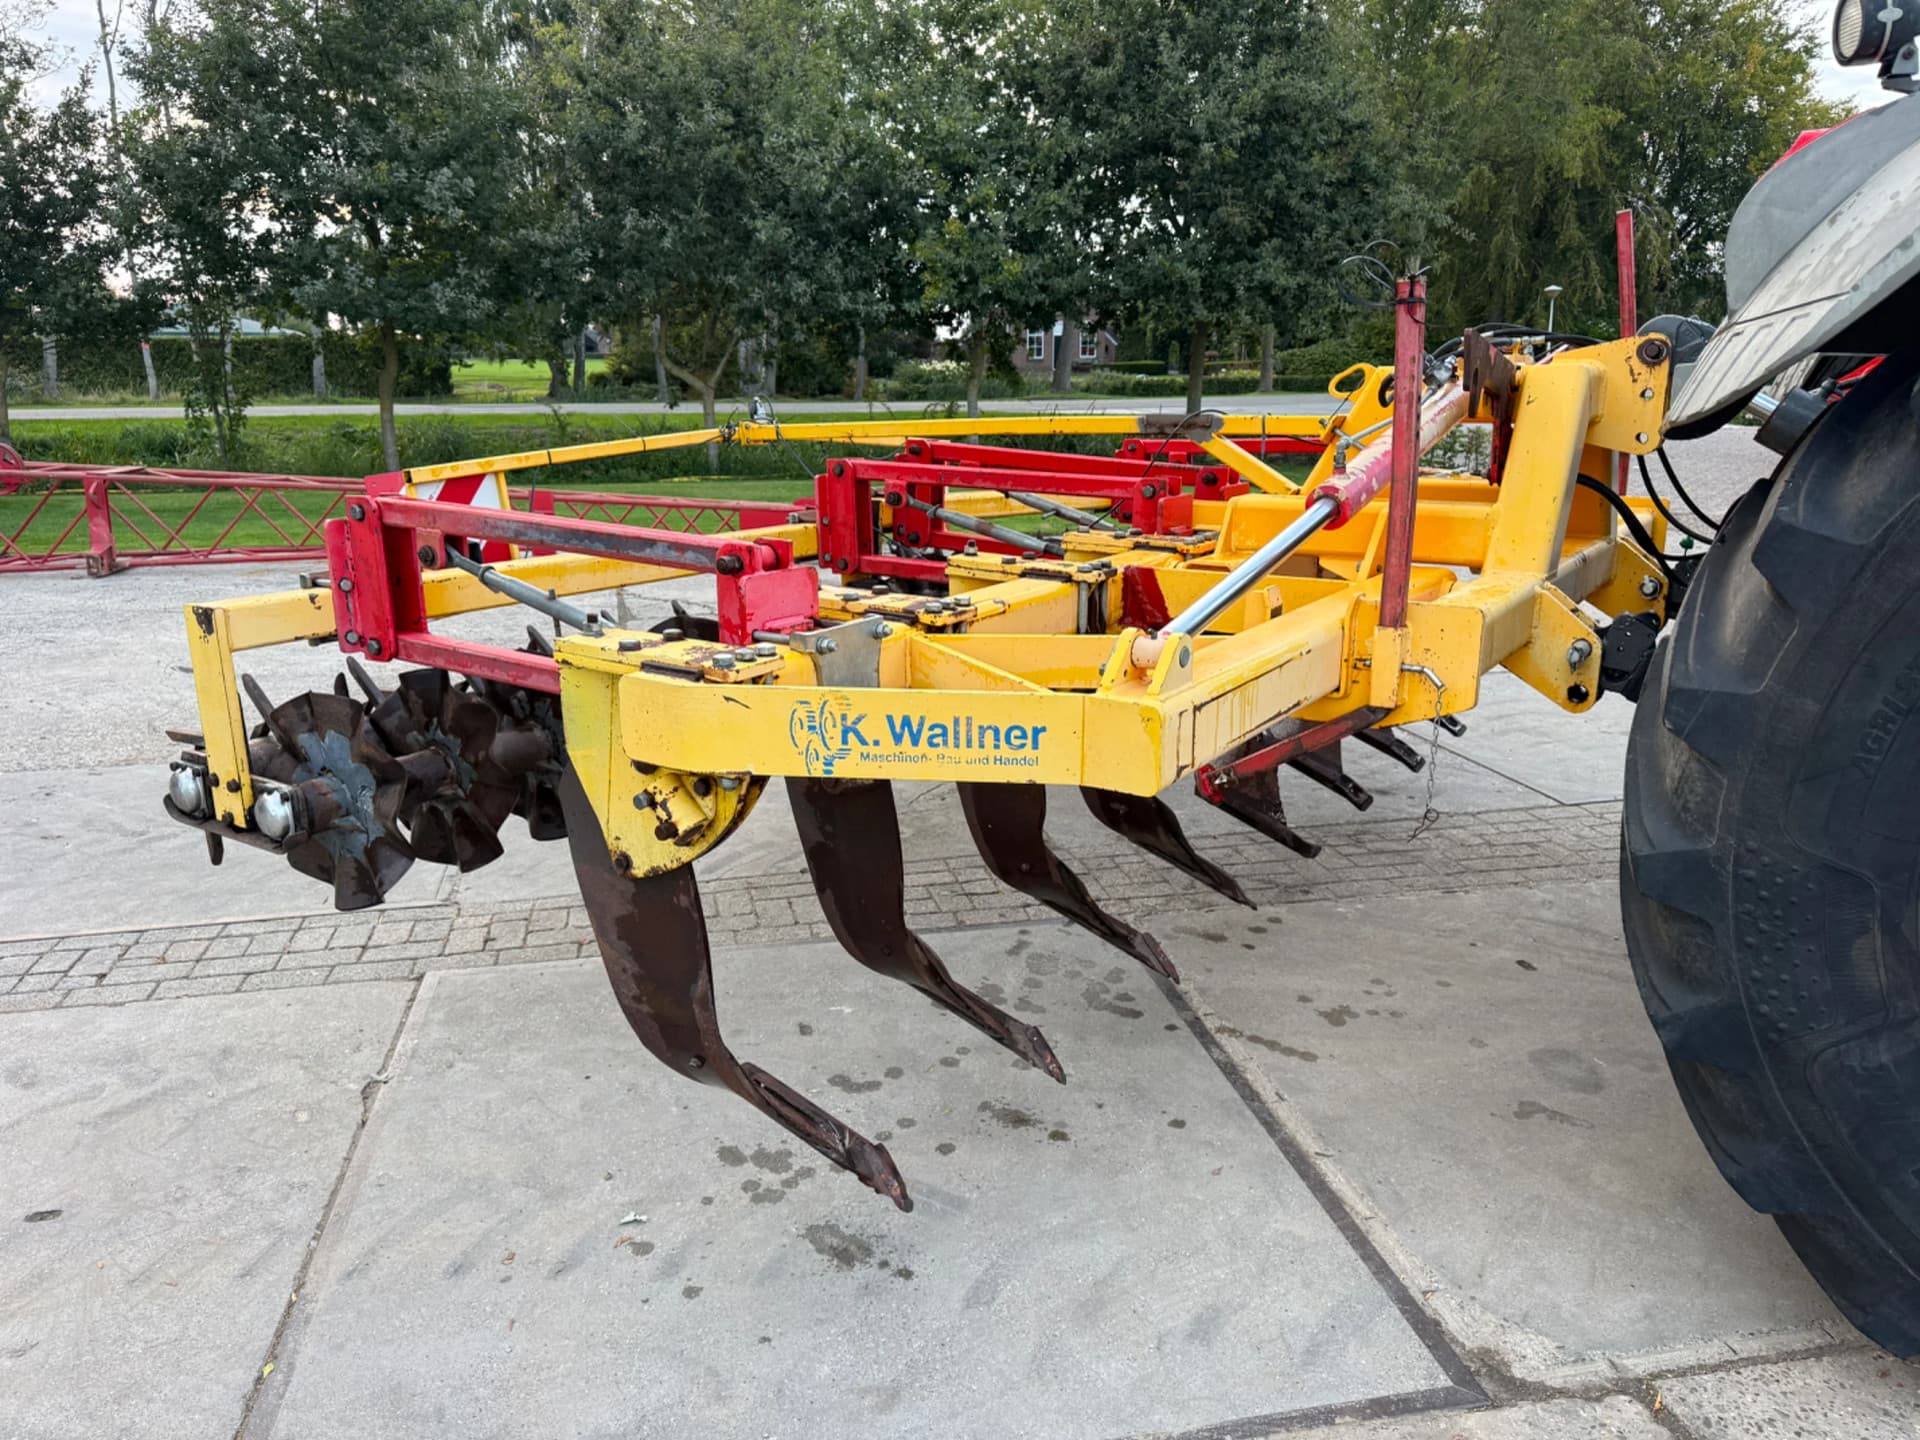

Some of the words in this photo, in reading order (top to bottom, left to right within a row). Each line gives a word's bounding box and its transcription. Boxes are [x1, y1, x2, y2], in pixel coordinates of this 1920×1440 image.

[840, 712, 880, 747] K.
[886, 714, 1047, 750] Wallner
[993, 755, 1040, 767] Handel
